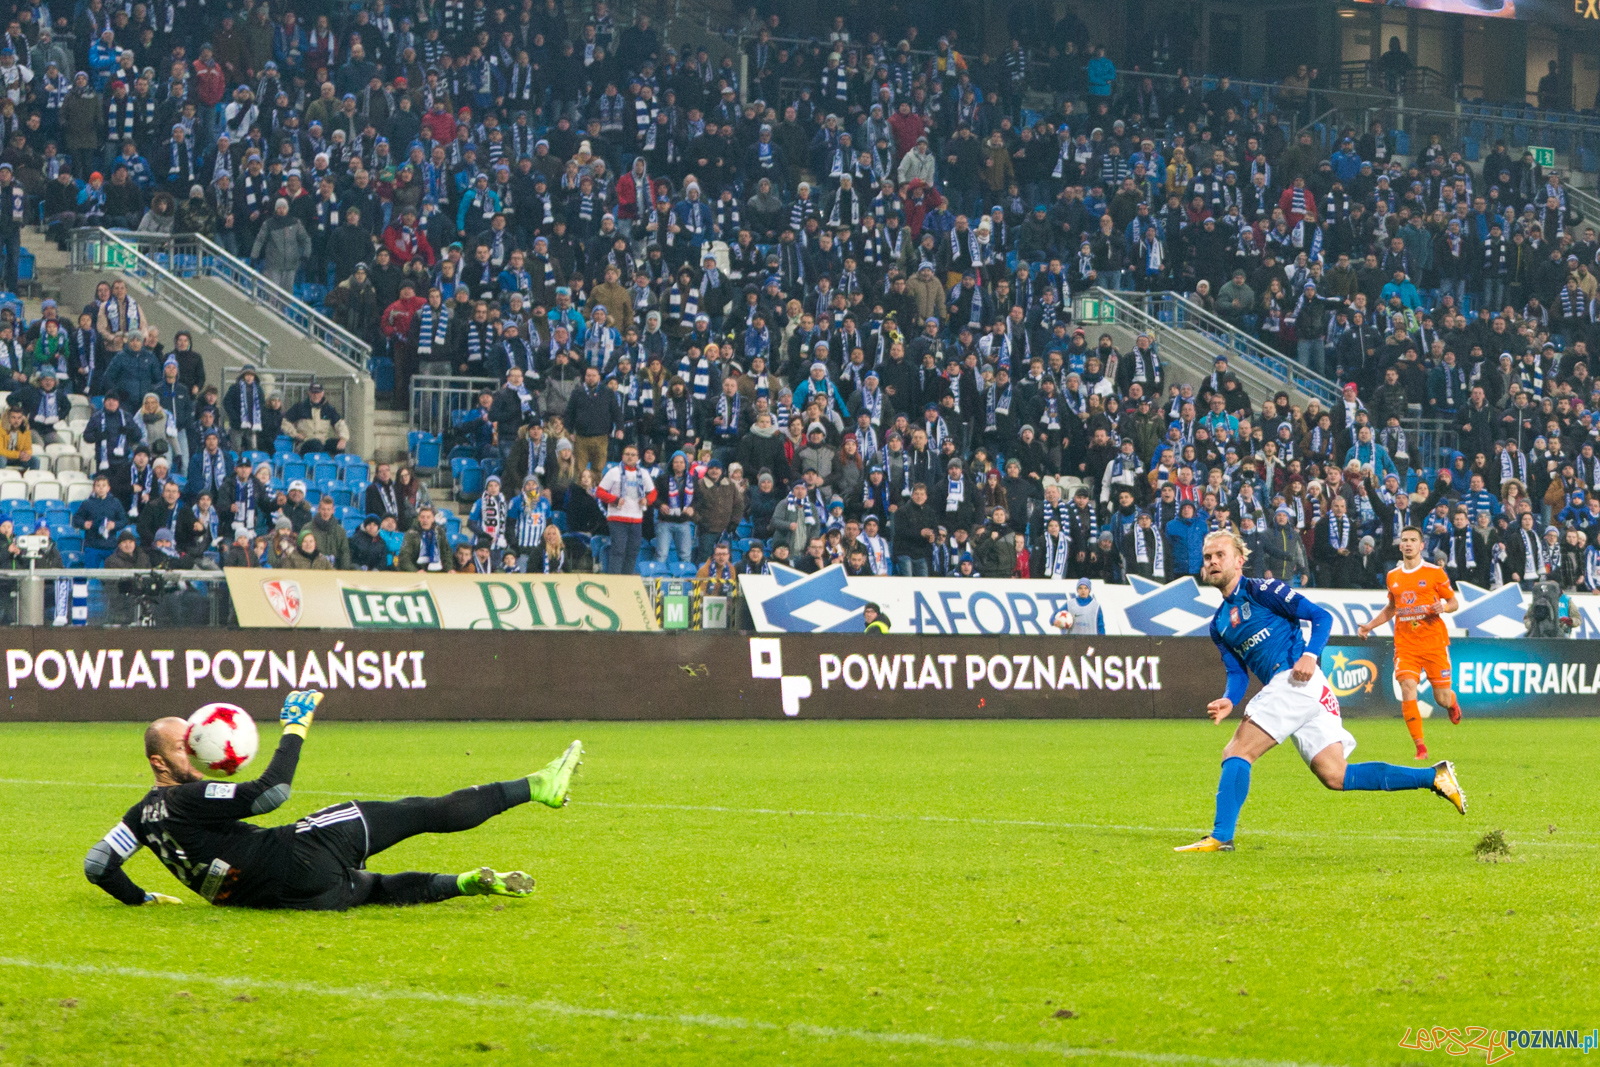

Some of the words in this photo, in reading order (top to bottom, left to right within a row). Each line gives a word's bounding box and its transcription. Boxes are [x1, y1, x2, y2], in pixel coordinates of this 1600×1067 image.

[1575, 0, 1600, 19] EX
[350, 594, 434, 624] LECH
[470, 581, 621, 631] PILS
[667, 603, 683, 622] M
[706, 603, 724, 620] 17
[909, 591, 1078, 635] AFORT
[6, 649, 174, 689] POWIAT
[185, 641, 427, 689] POZNAŃSKI
[820, 654, 957, 690] POWIAT
[966, 647, 1161, 690] POZNAŃSKI
[1336, 666, 1368, 689] LOTTO
